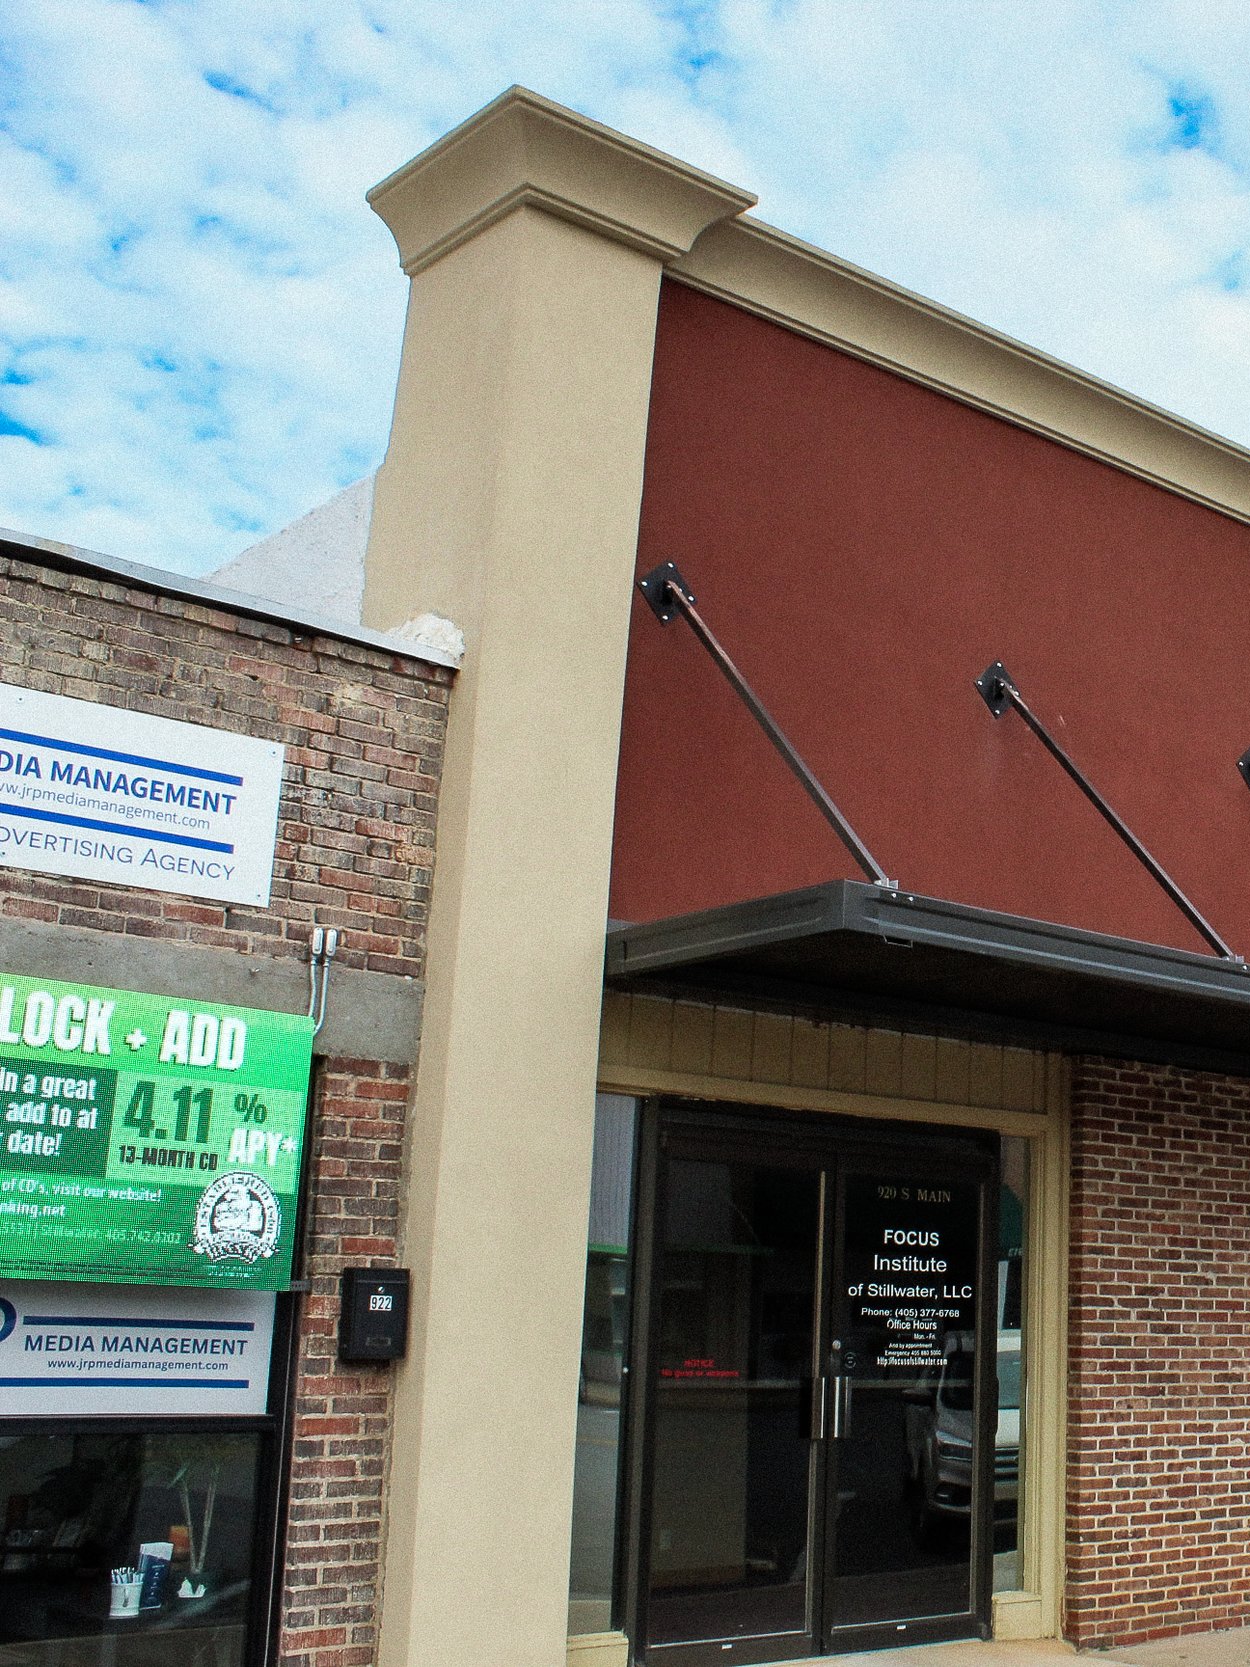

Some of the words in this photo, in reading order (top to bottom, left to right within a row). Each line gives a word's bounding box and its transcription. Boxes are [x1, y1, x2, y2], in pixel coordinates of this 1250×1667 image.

[50, 761, 237, 815] MANAGEMENT
[140, 848, 236, 880] AGENCY
[0, 986, 116, 1056] LOCK
[159, 1010, 247, 1071] ADD
[22, 1074, 36, 1094] a
[40, 1075, 97, 1100] great
[6, 1101, 47, 1125] add
[51, 1104, 71, 1127] to
[77, 1108, 98, 1129] at
[123, 1080, 213, 1144] 4.11
[8, 1129, 62, 1156] date!
[119, 1144, 194, 1168] 13-MONTH
[199, 1153, 218, 1171] CD
[2, 1178, 17, 1191] of
[52, 1182, 81, 1196] visit
[84, 1187, 105, 1198] our
[108, 1187, 161, 1202] website!
[877, 1186, 897, 1199] 920
[901, 1188, 910, 1200] S
[917, 1189, 951, 1203] MAIN
[884, 1229, 939, 1247] FOCUS
[874, 1254, 947, 1273] Institute
[371, 1296, 391, 1310] 922
[848, 1283, 864, 1297] of
[867, 1283, 938, 1300] Stillwater,
[943, 1285, 972, 1299] LLC
[861, 1307, 893, 1317] Phone:
[895, 1308, 918, 1318] (405)
[920, 1308, 960, 1318] 377-6768
[886, 1319, 911, 1330] Office
[913, 1319, 937, 1330] Hours
[23, 1334, 95, 1353] MEDIA
[101, 1336, 249, 1356] MANAGEMENT
[47, 1358, 228, 1372] www.jrpmediamanagement.com
